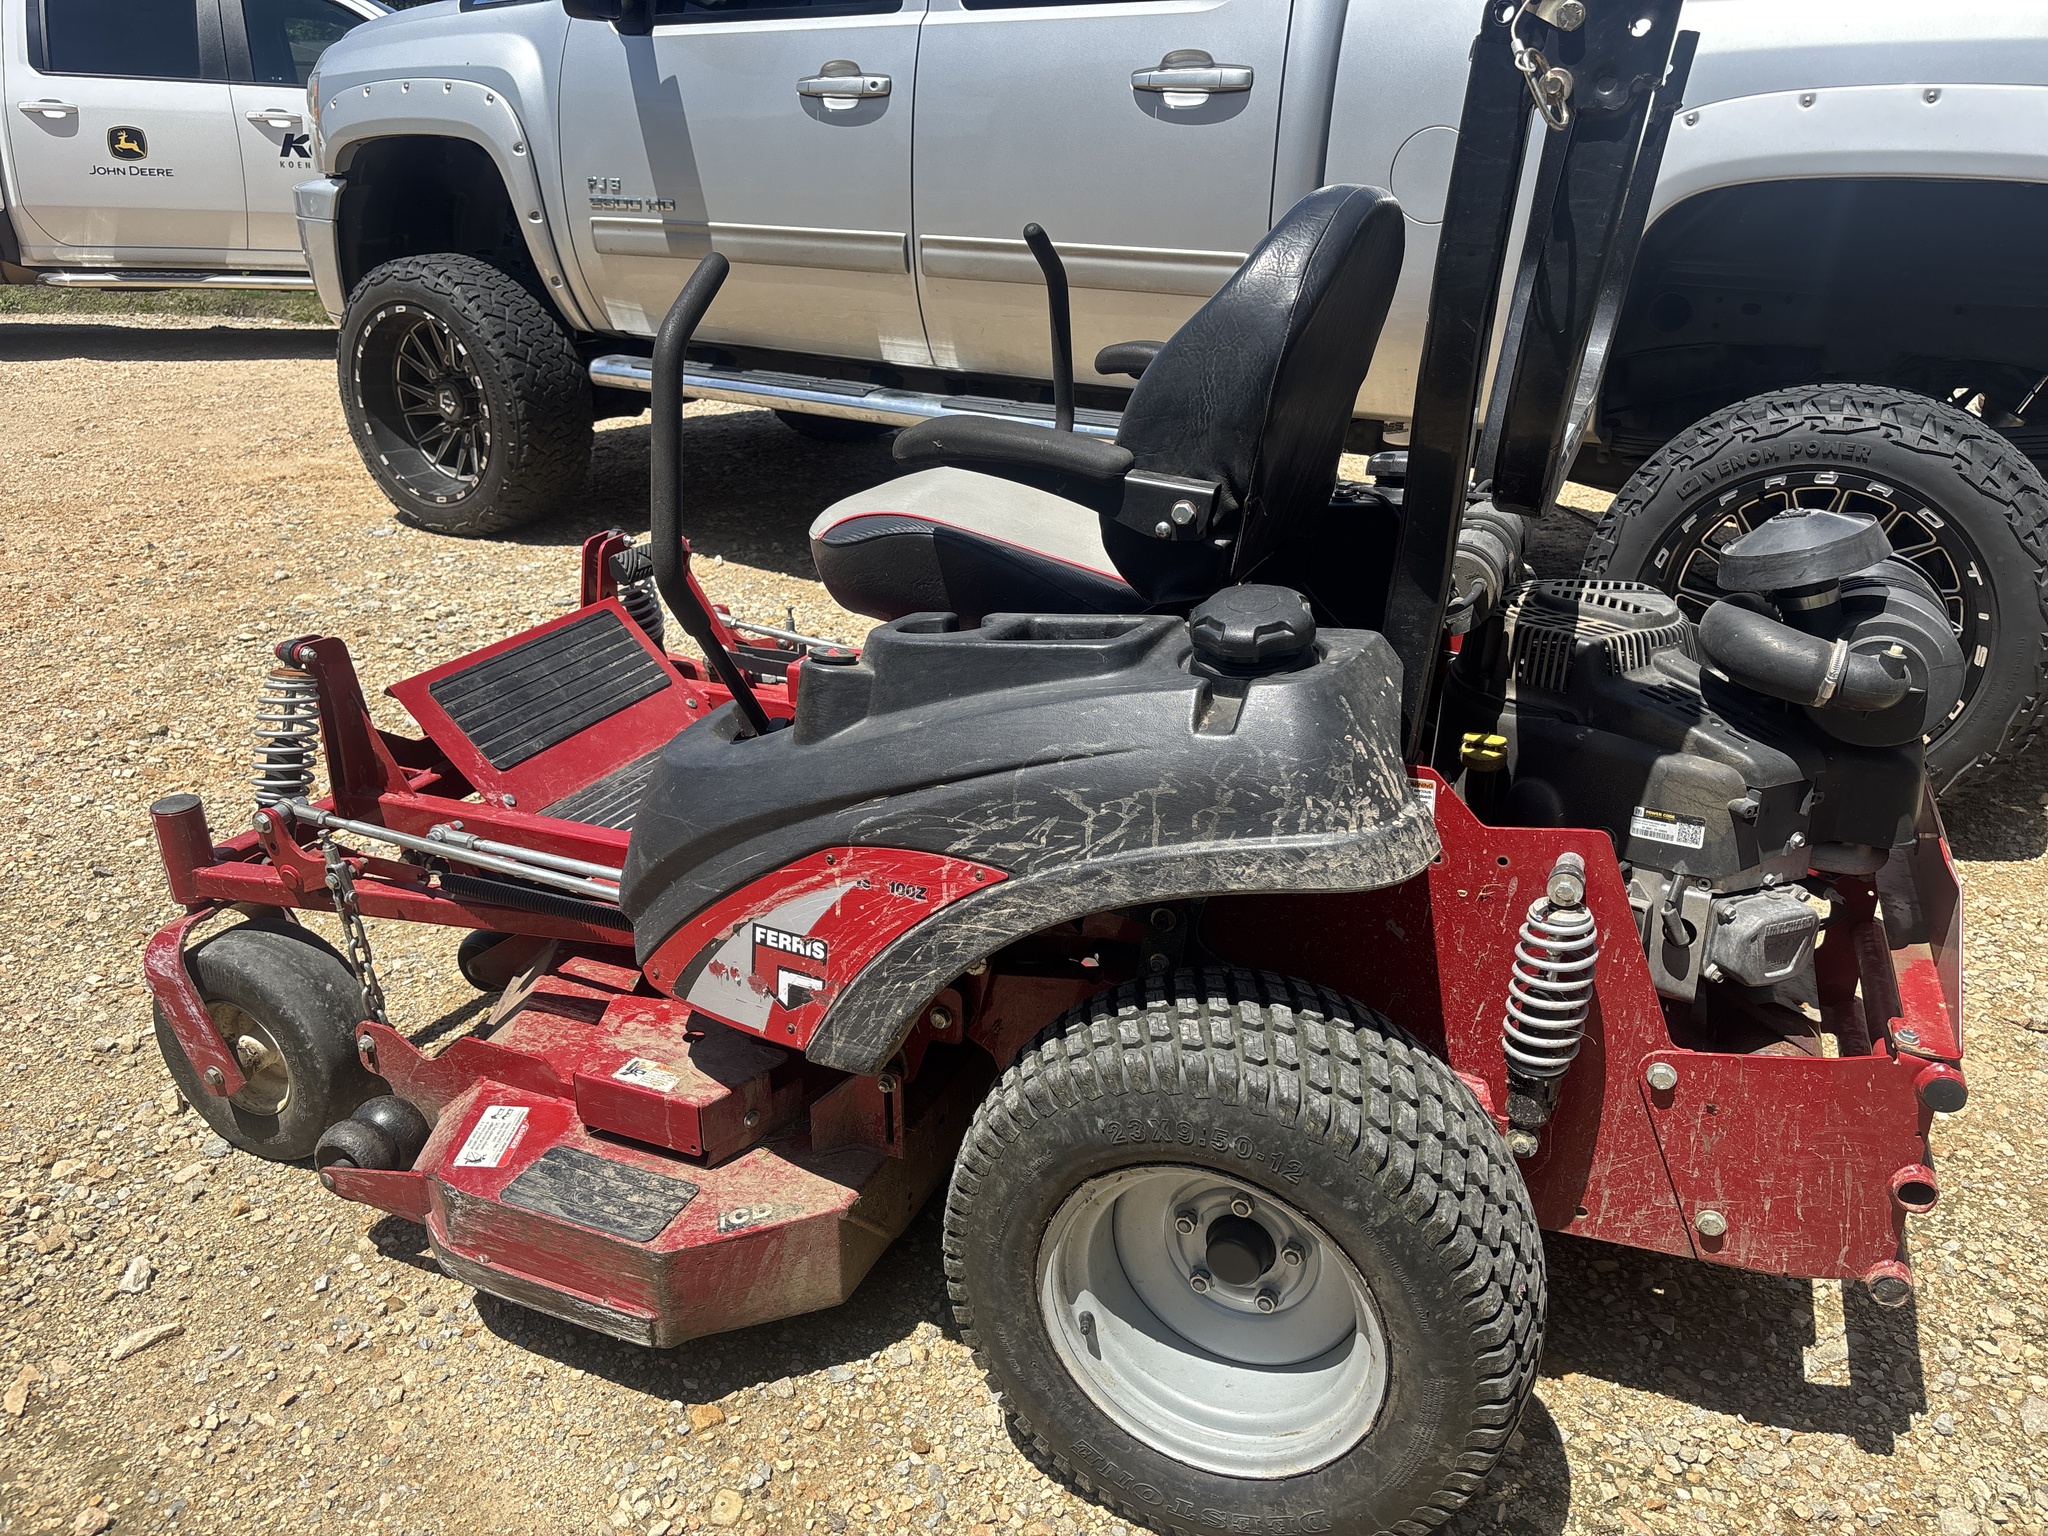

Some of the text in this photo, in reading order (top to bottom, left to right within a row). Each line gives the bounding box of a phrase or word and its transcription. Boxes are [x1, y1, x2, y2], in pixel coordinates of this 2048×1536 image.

[89, 164, 174, 177] JOHN DEERE
[1702, 440, 1871, 483] VENOM POWER
[1654, 472, 1945, 569] OFFROAD
[755, 926, 826, 960] FERRIS
[509, 1125, 526, 1149] DANGER
[1107, 1118, 1304, 1185] 23X9.50-12
[1361, 1222, 1431, 1334] NOT FOR HIGHWAY SERVICE
[1069, 1439, 1332, 1535] DEESTONE
